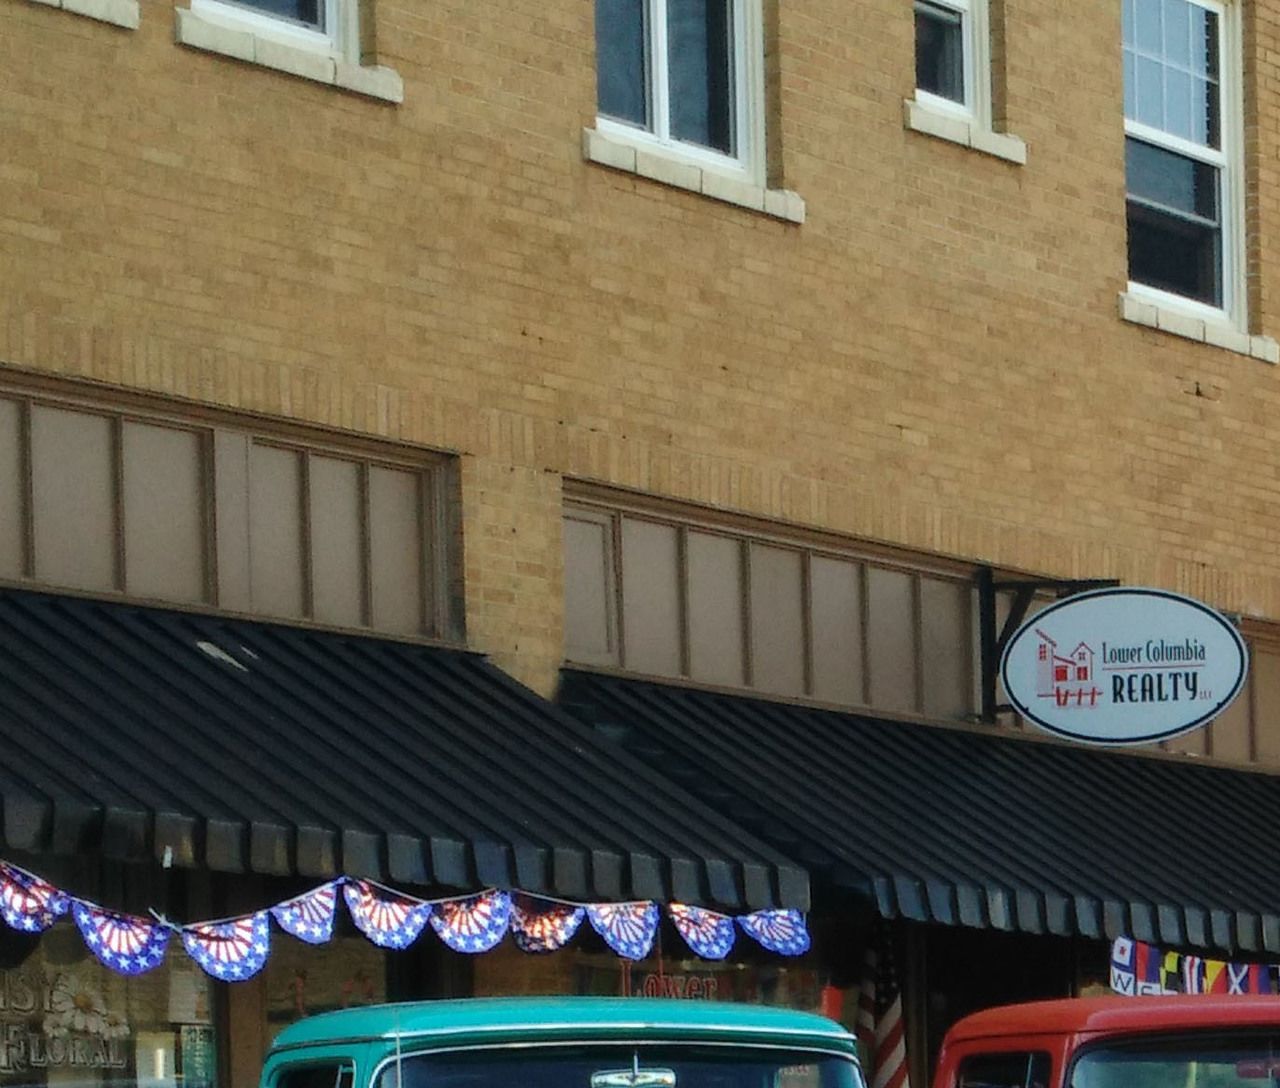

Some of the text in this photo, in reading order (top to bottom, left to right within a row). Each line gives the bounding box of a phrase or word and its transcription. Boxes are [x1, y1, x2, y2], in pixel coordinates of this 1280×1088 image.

[1103, 639, 1205, 664] Lower Columbia
[1112, 672, 1198, 703] REALTY
